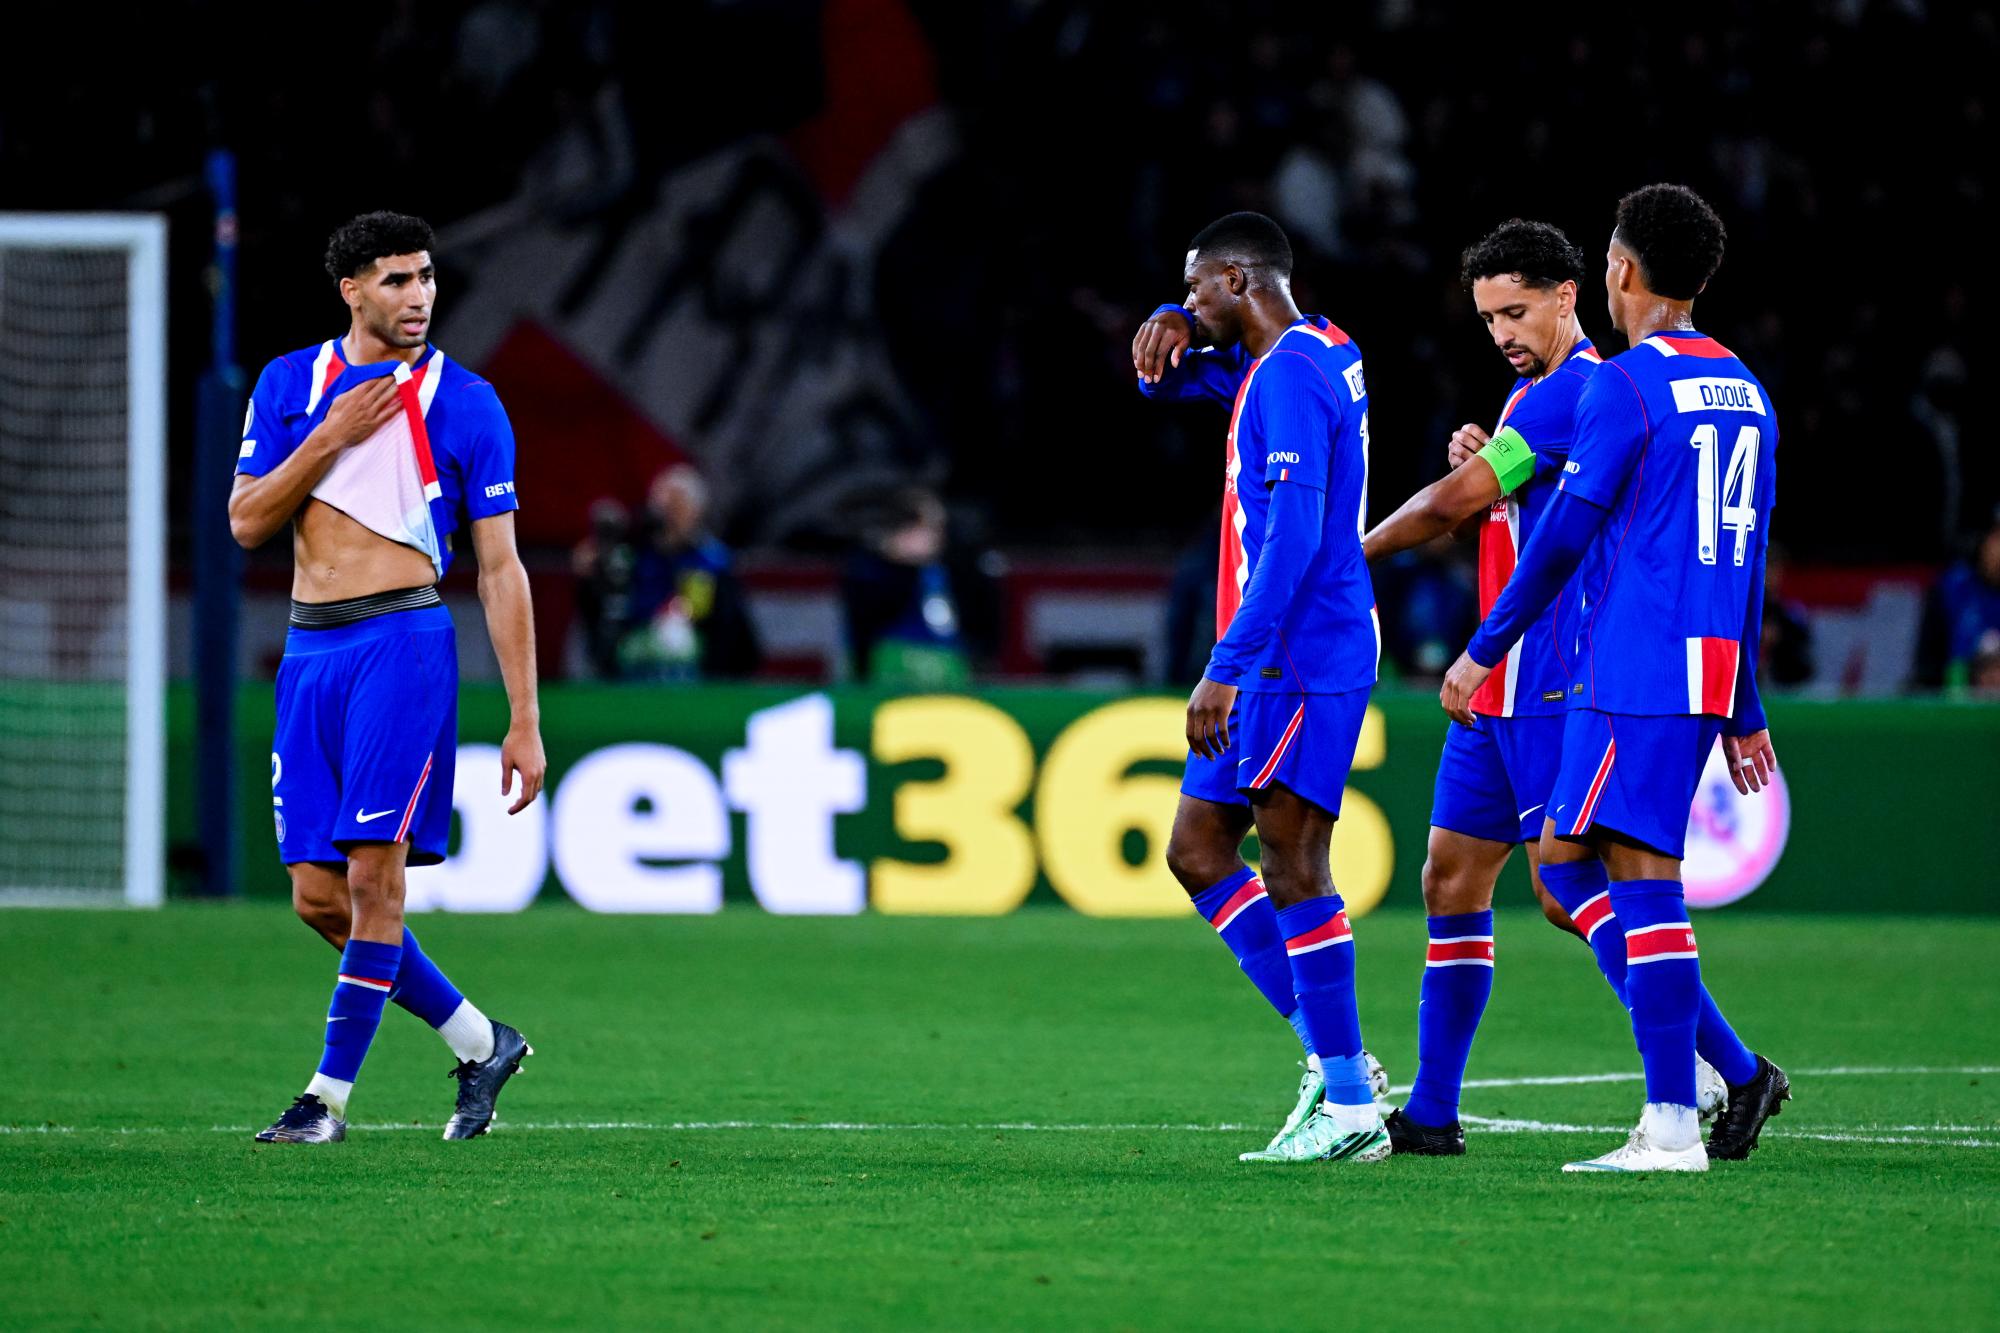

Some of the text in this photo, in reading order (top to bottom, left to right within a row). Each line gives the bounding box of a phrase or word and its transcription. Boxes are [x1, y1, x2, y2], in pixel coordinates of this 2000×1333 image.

[1700, 383, 1753, 408] D.DOUÉ
[485, 481, 515, 498] BEY
[1690, 424, 1760, 566] 14
